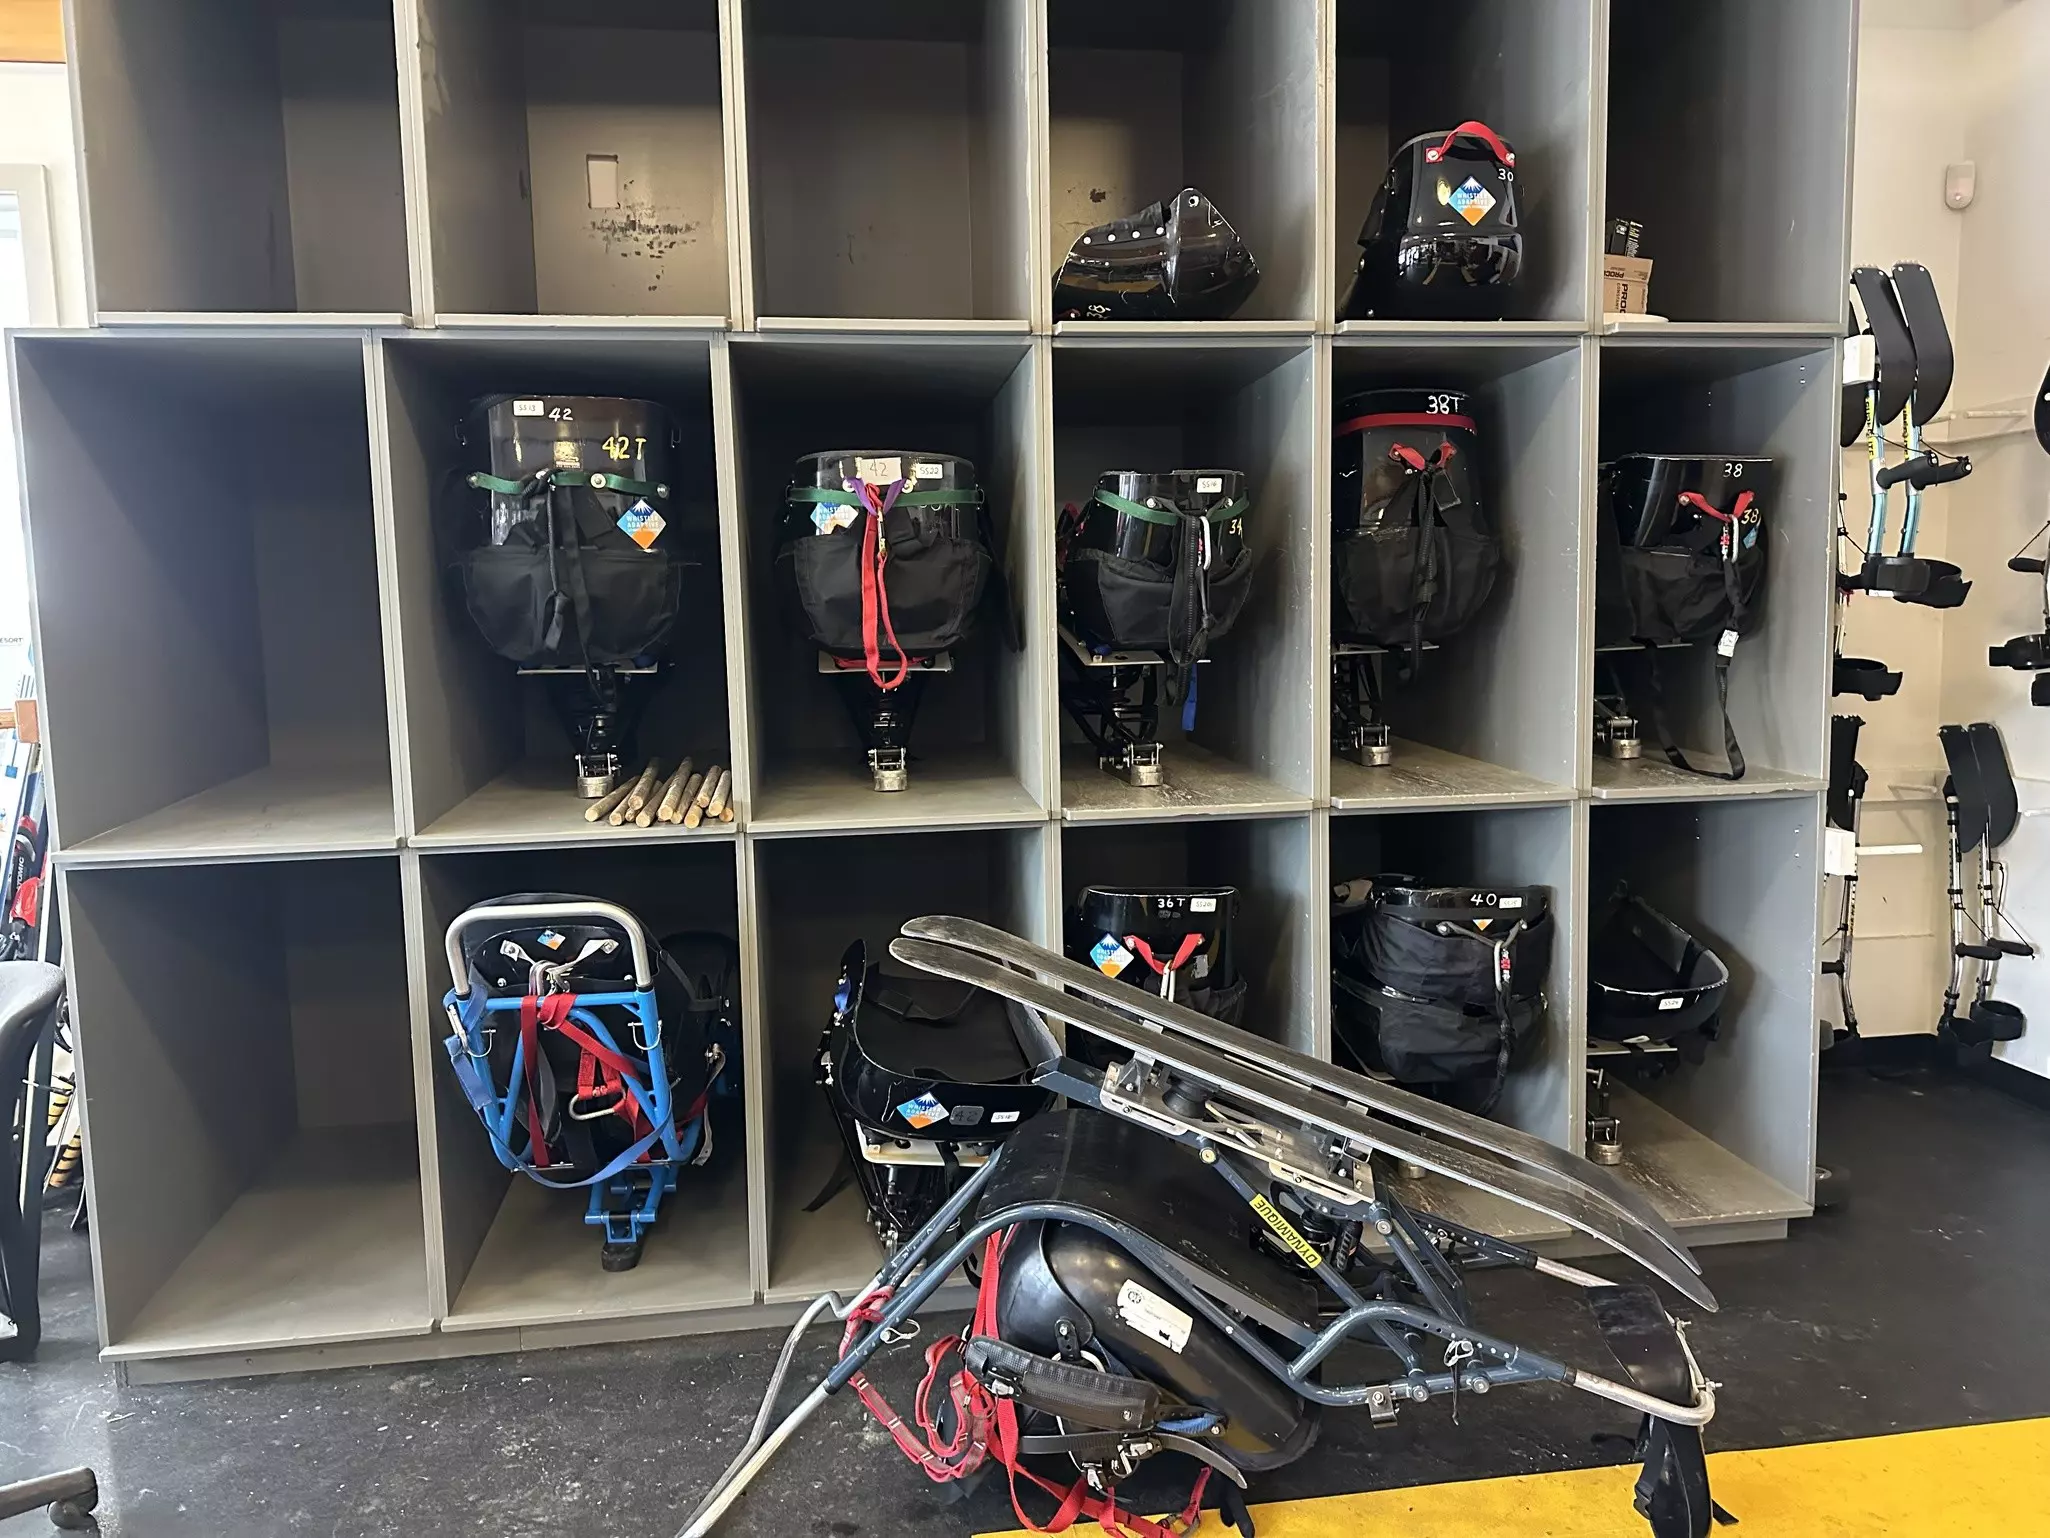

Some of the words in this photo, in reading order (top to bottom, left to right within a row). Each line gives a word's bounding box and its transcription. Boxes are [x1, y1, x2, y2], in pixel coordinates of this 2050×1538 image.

[1498, 168, 1514, 182] 30
[1426, 394, 1460, 415] 38T
[548, 407, 574, 422] 42
[869, 459, 888, 477] 42
[919, 466, 939, 475] SS22
[1723, 463, 1743, 478] 38
[16, 857, 25, 886] TOMIC
[1470, 893, 1497, 906] 40
[1254, 1199, 1318, 1264] DYNAMIQUE
